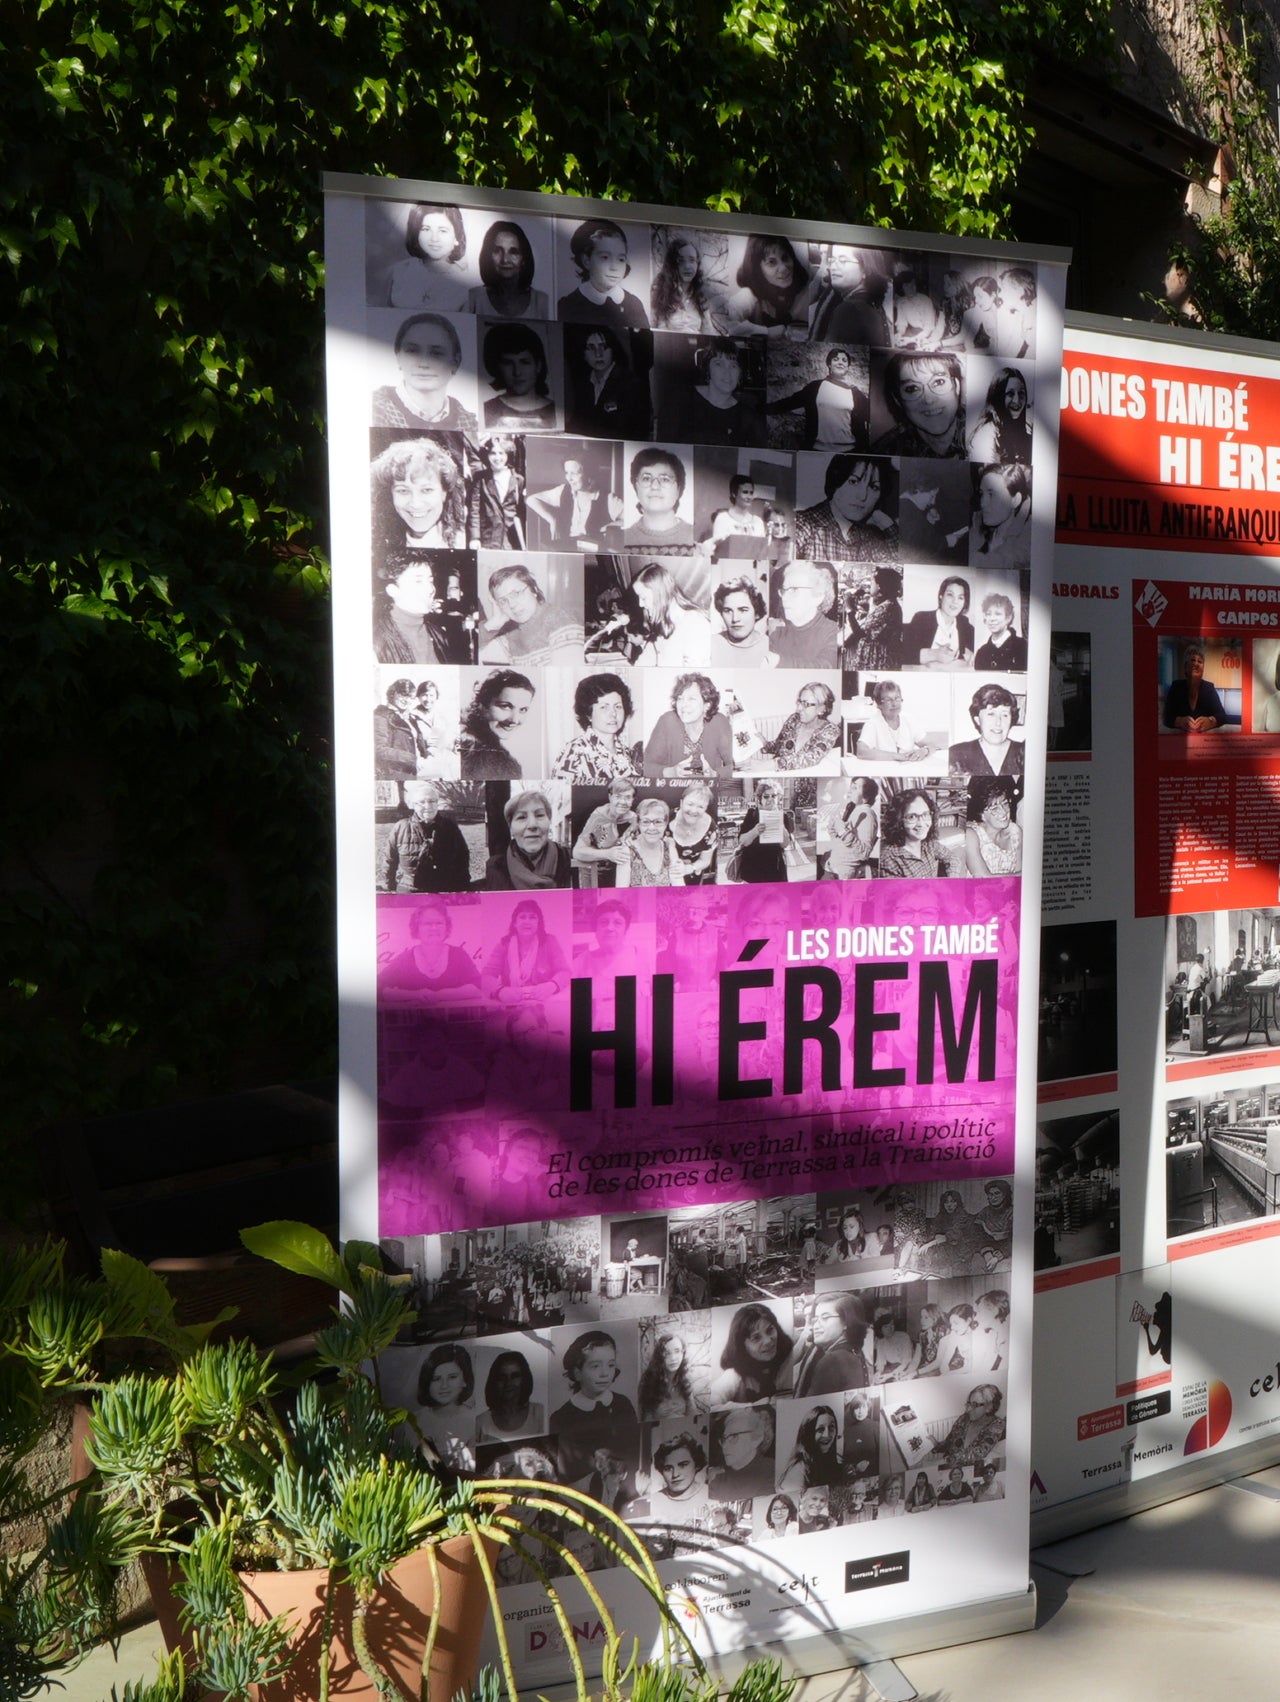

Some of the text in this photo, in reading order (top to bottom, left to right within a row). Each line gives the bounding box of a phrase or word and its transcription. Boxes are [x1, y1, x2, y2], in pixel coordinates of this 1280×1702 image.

[1152, 381, 1249, 431] TAMBÉ
[1159, 435, 1202, 486] HI
[1088, 495, 1151, 534] LLUITA
[1051, 582, 1120, 600] ABORALS
[1217, 611, 1279, 626] CAMPOS
[787, 918, 999, 961] LES DONES TAMBÉ
[569, 938, 999, 1113] HI ÉREM
[546, 1117, 997, 1179] El compromís veïnal, sindical i polític
[548, 1139, 996, 1199] de les dones de Terrassa a la Transició
[1091, 1419, 1121, 1432] Terrassa
[1182, 1407, 1207, 1419] TERRASSA
[1081, 1460, 1122, 1479] Terrassa
[1133, 1443, 1173, 1462] Memòria
[503, 1604, 556, 1621] organitz
[703, 1599, 751, 1614] Terrassa
